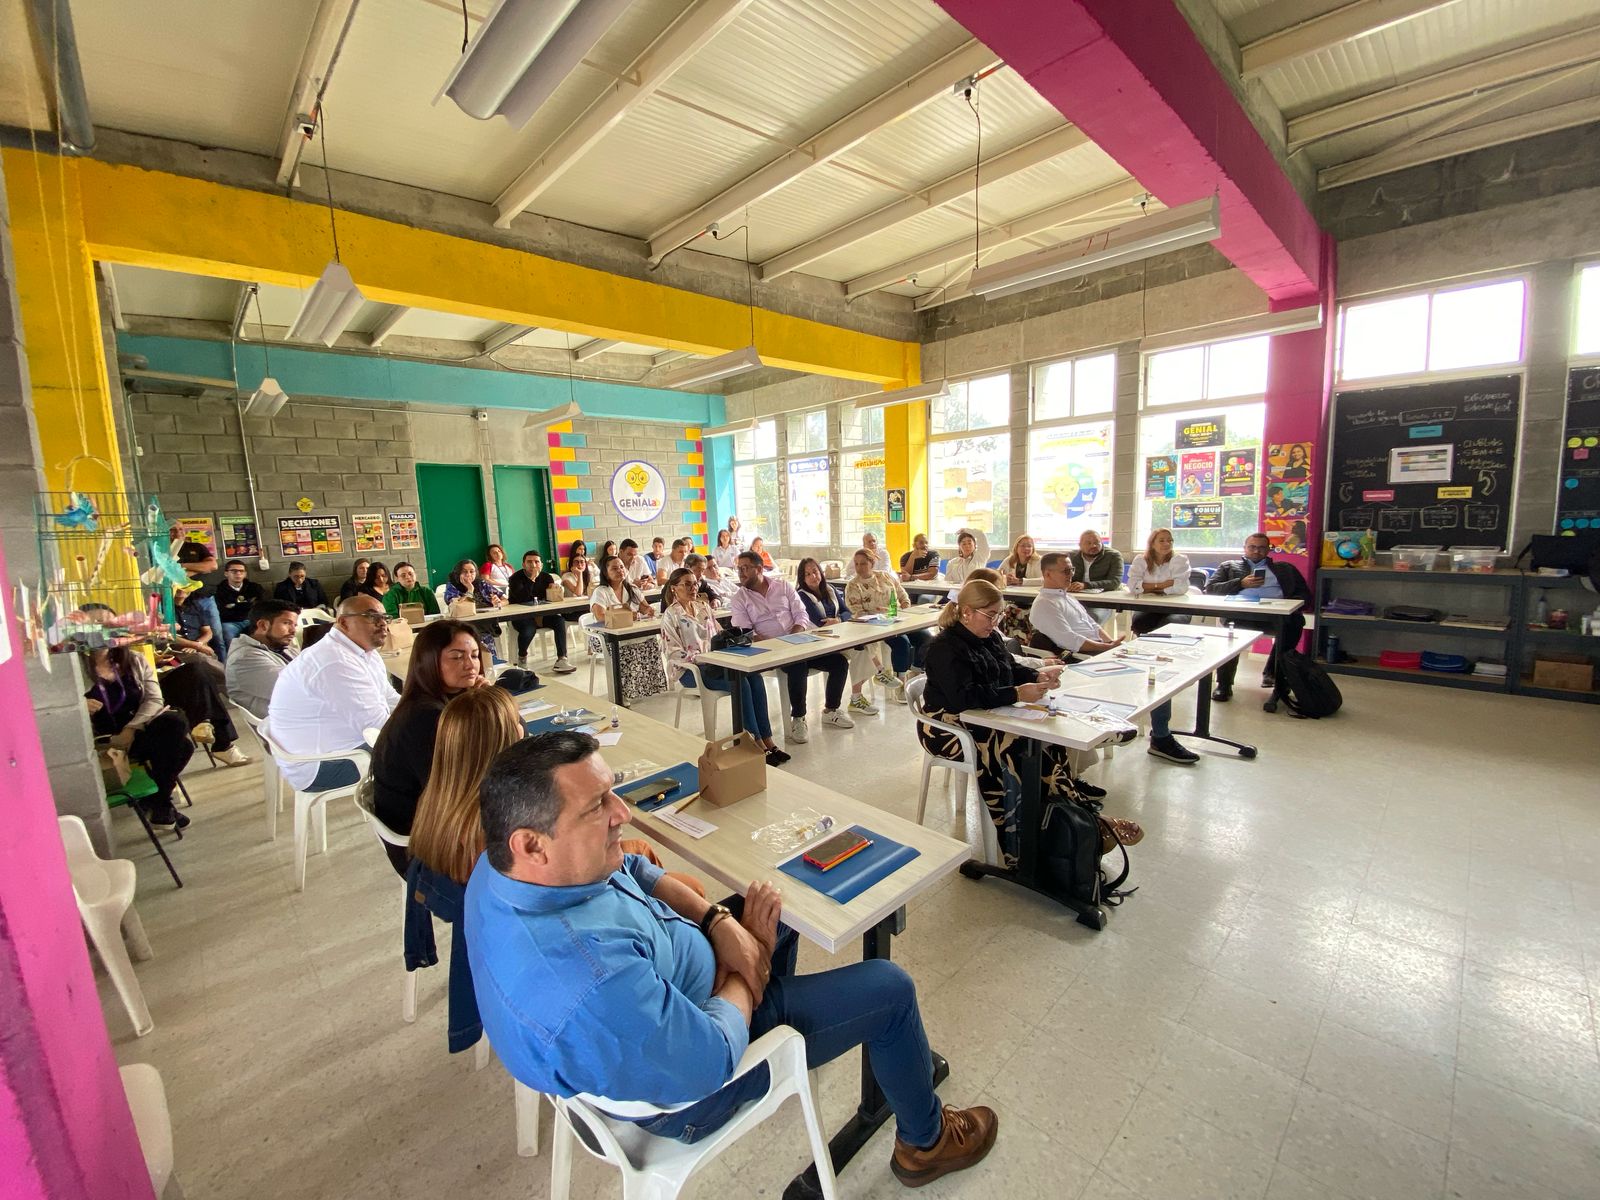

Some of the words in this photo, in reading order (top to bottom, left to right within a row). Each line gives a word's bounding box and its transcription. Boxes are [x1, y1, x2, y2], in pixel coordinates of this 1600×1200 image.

[1183, 425, 1218, 434] GENIAL
[1183, 461, 1213, 470] NEGOCIO
[281, 518, 337, 527] DECISIONES
